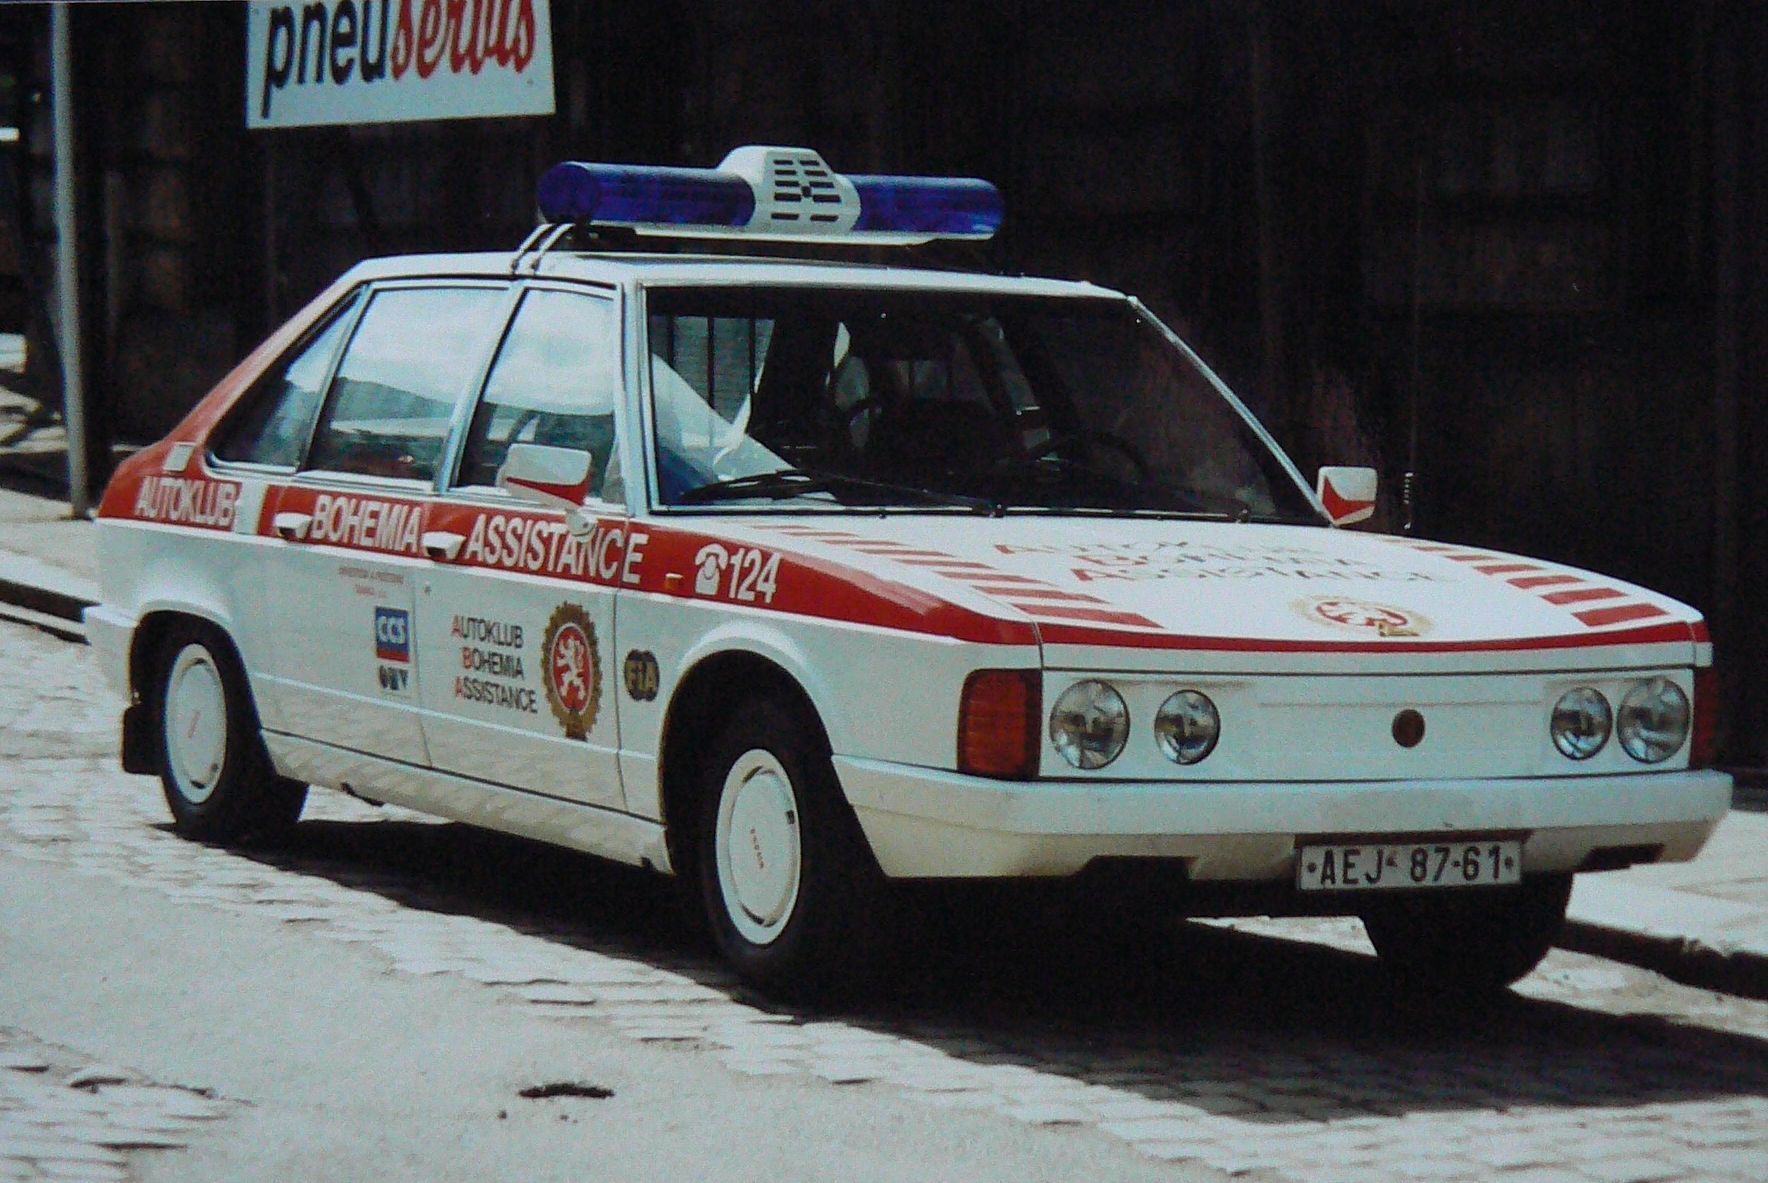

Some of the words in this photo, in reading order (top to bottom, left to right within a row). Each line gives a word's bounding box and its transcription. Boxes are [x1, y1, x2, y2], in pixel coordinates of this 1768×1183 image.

[133, 475, 238, 527] AUTOKLUB
[309, 494, 422, 554] BOHEMIA
[463, 513, 650, 585] ASSISTANCE
[728, 547, 783, 605] 124
[450, 614, 524, 649] AUTOKLUB
[462, 646, 525, 681] BOHEMIA
[454, 676, 539, 714] ASSISTANCE
[1320, 848, 1386, 886] AEJ
[1409, 845, 1503, 884] 87-61
